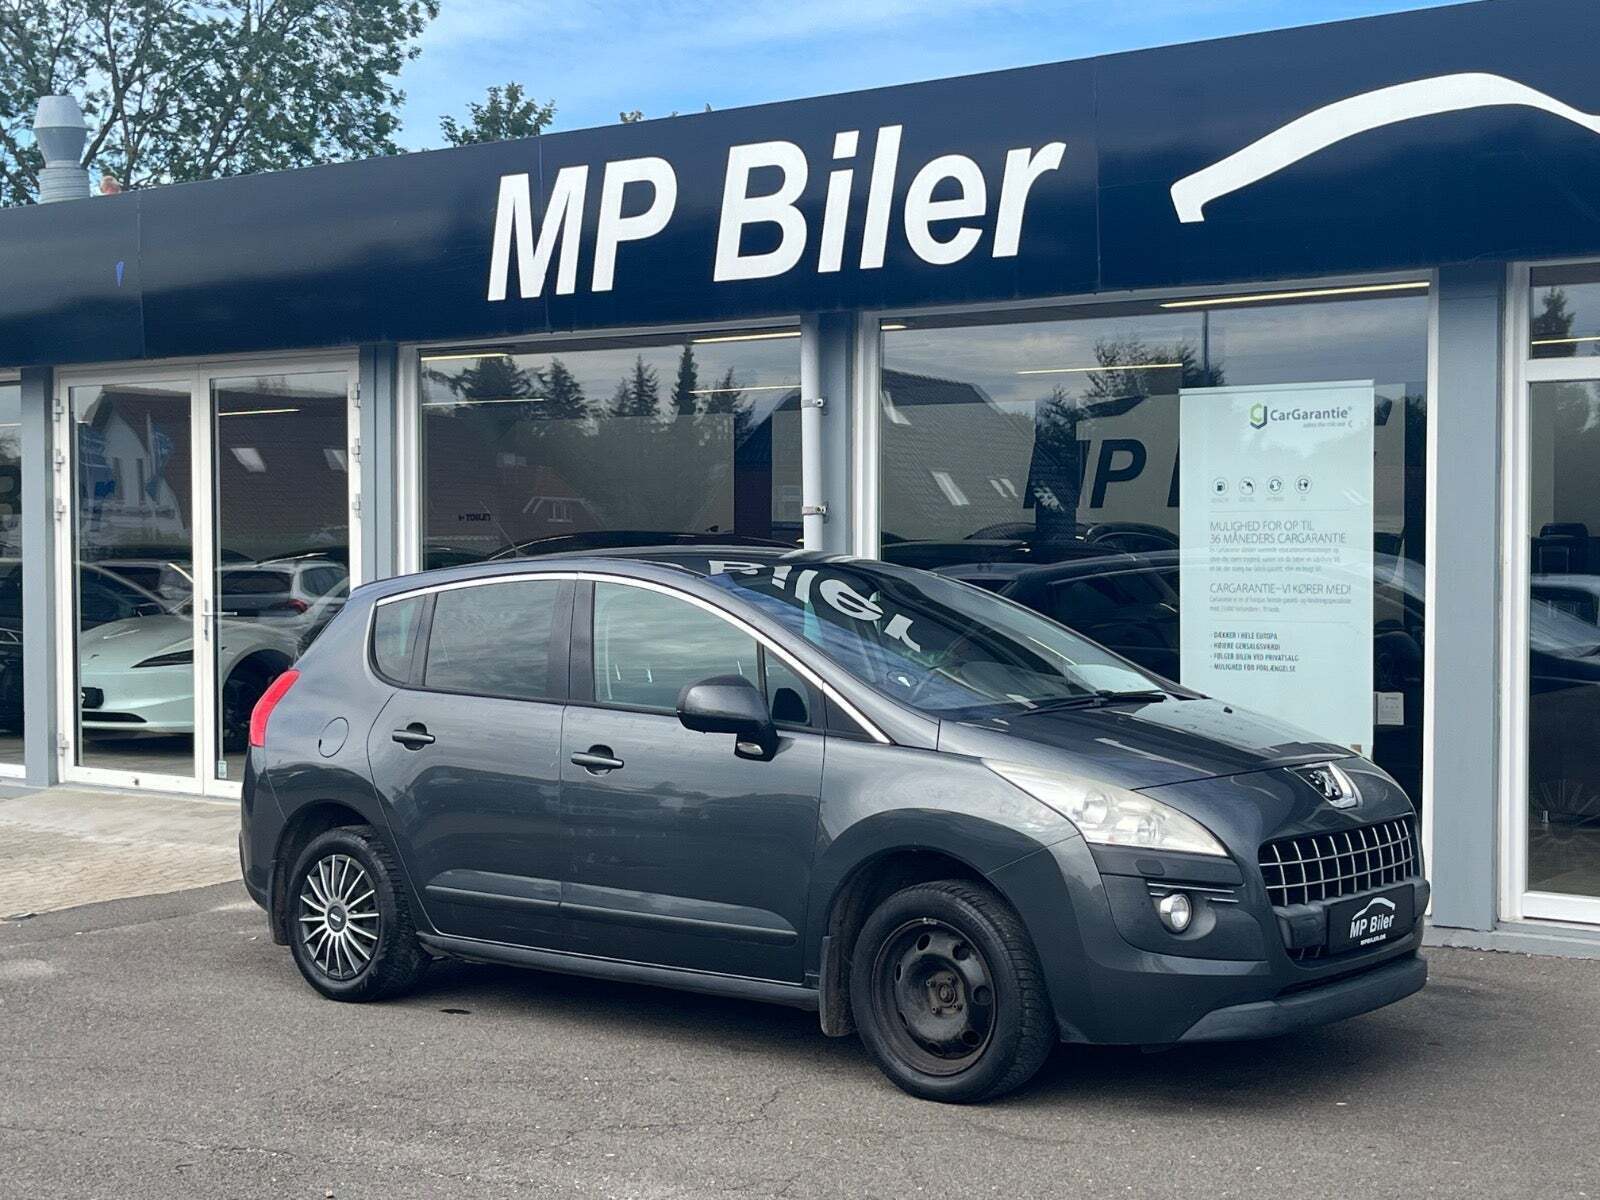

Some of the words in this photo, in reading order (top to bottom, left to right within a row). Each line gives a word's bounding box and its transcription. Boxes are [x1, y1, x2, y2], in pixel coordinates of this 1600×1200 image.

[487, 156, 678, 301] MP
[713, 124, 1067, 282] Biler
[1209, 521, 1260, 532] MULIGHED
[1263, 520, 1282, 531] FOR
[1284, 520, 1299, 531] OP
[1300, 520, 1314, 531] TIL
[1209, 534, 1221, 544] 36
[1223, 531, 1275, 544] MÅNEDERS
[1277, 533, 1347, 544] CARGARANTIE
[1349, 918, 1368, 939] MP
[1369, 914, 1395, 933] Biler
